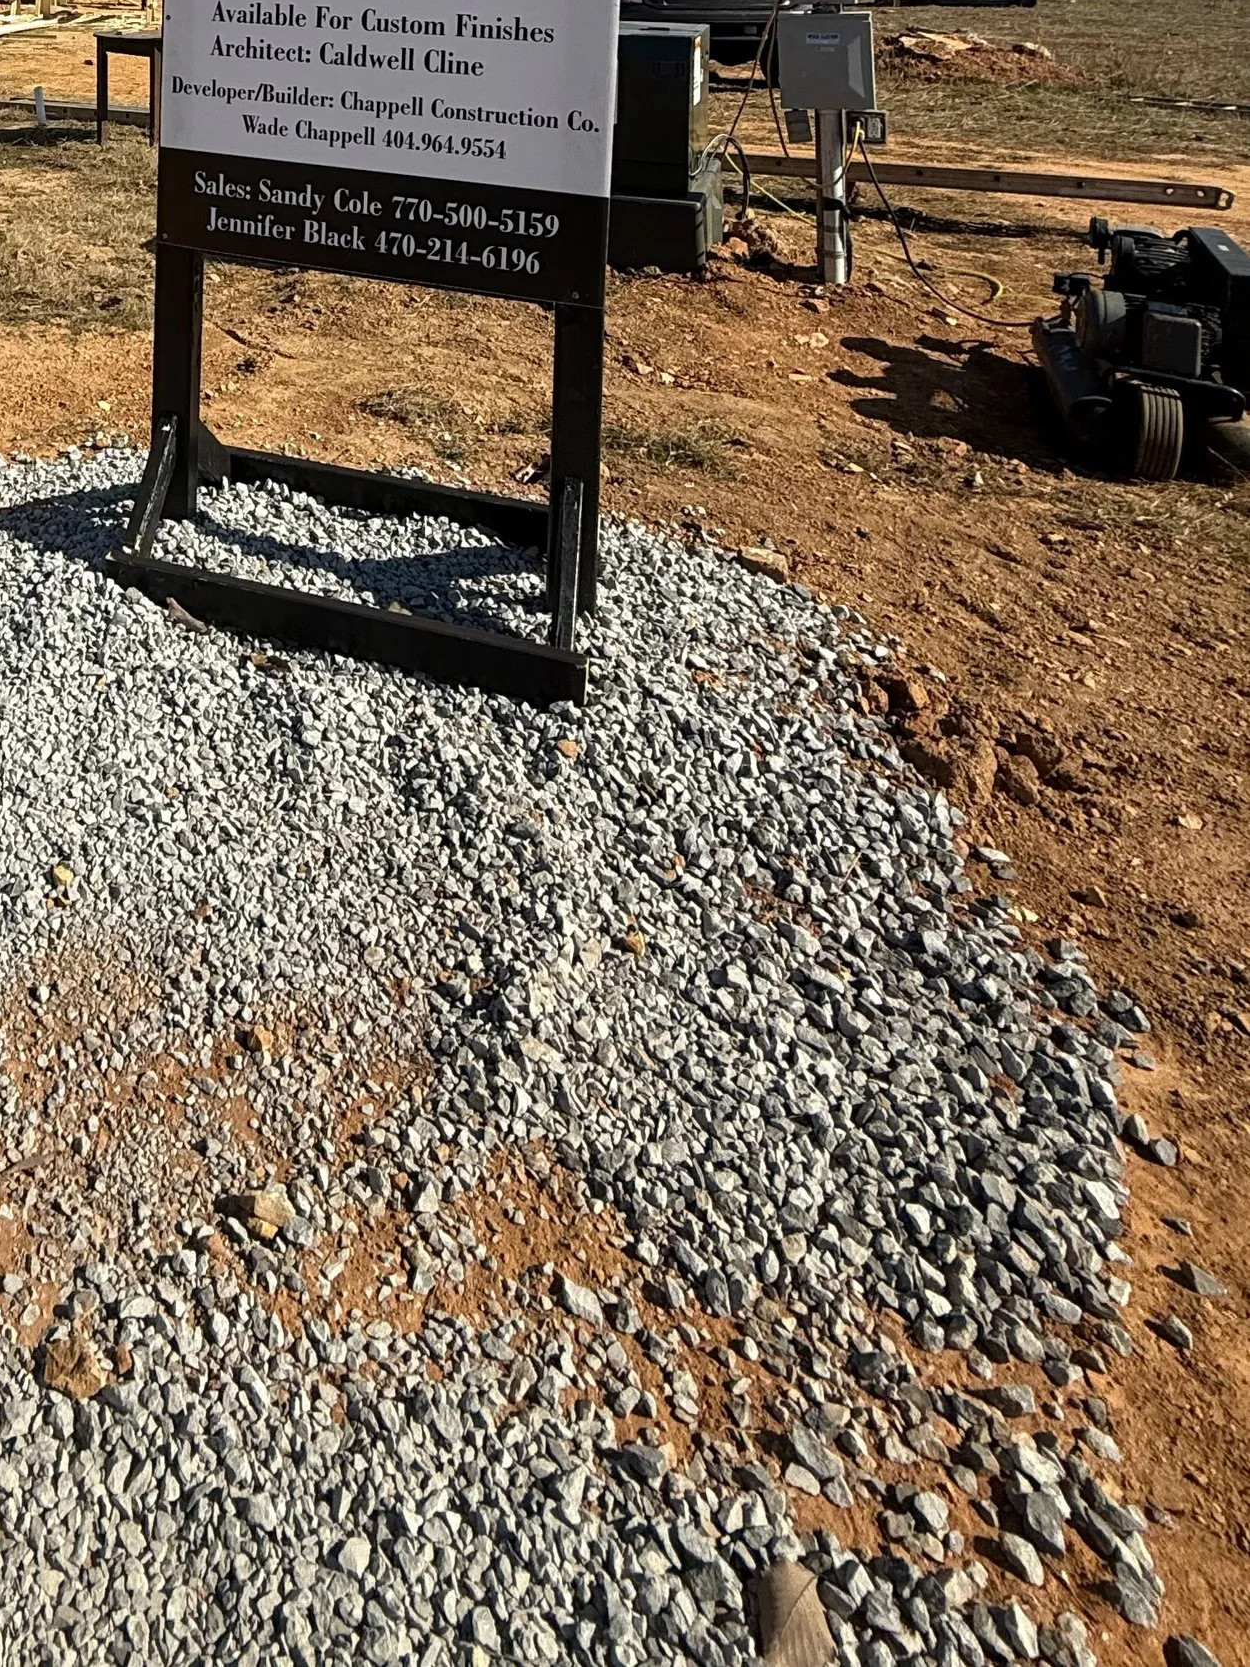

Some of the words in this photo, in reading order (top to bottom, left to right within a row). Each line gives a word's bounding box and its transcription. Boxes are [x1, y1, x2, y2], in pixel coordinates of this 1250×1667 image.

[211, 0, 307, 28] Available
[315, 5, 353, 30] For
[361, 8, 446, 37] Custom
[455, 13, 555, 44] Finishes
[210, 34, 312, 64] Architect:
[319, 41, 415, 71] Caldwell
[423, 48, 485, 77] Cline
[171, 75, 335, 109] Developer/Builder:
[340, 90, 424, 122] Chappell
[431, 97, 559, 130] Construction
[567, 109, 601, 134] Co.
[242, 113, 290, 138] Wade
[295, 119, 376, 150] Chappell
[381, 129, 507, 160] 404.964.9554
[194, 170, 252, 201] Sales:
[257, 179, 326, 216] Sandy
[333, 188, 383, 217] Cole
[391, 195, 561, 239] 770-500-5159
[206, 206, 296, 241] Jennifer
[303, 219, 367, 252] Black
[373, 230, 541, 275] 470-214-6196
